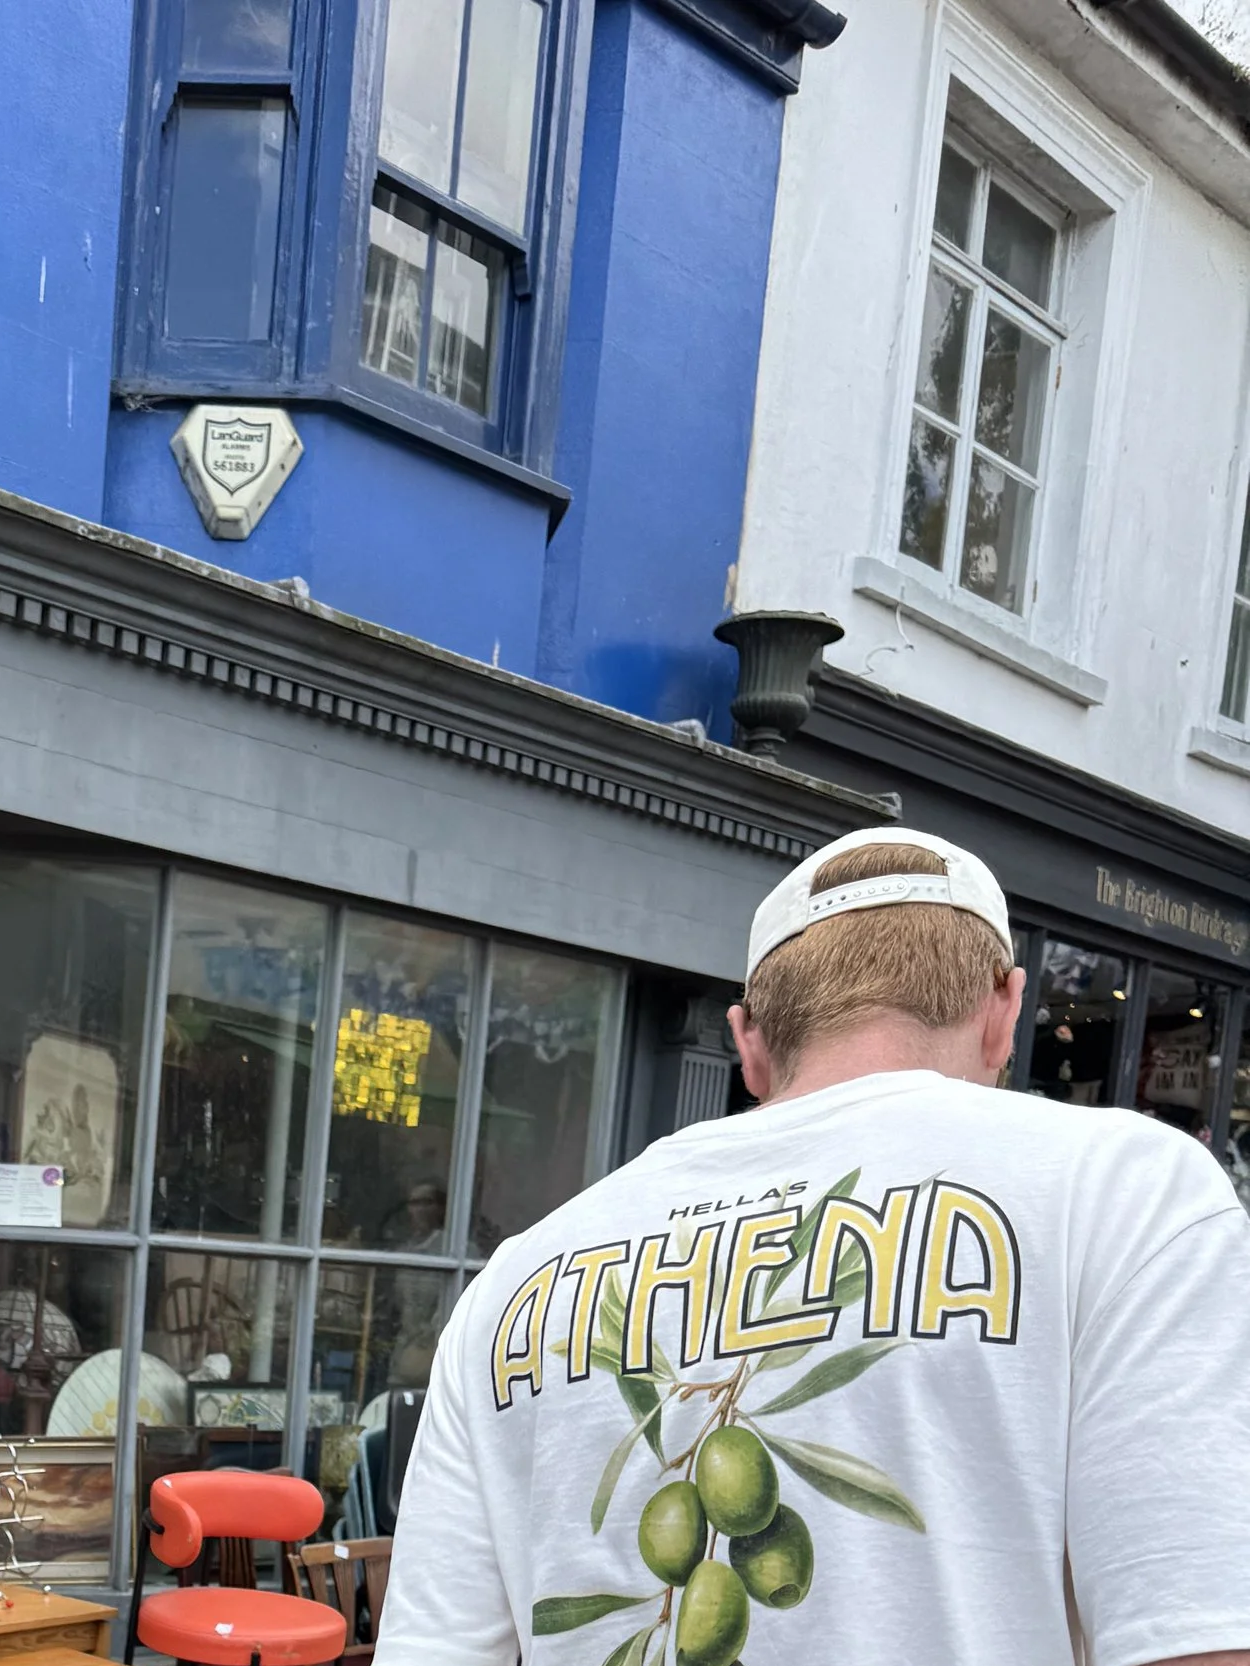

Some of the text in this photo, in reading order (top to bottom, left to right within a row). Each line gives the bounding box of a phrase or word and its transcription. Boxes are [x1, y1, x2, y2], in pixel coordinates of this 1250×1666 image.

[211, 429, 264, 443] LanGuard
[212, 460, 256, 473] 561883
[1095, 865, 1122, 908] The
[1124, 877, 1189, 930] Brighton
[668, 1180, 809, 1222] HELLAS
[492, 1179, 1022, 1413] ATHENA
